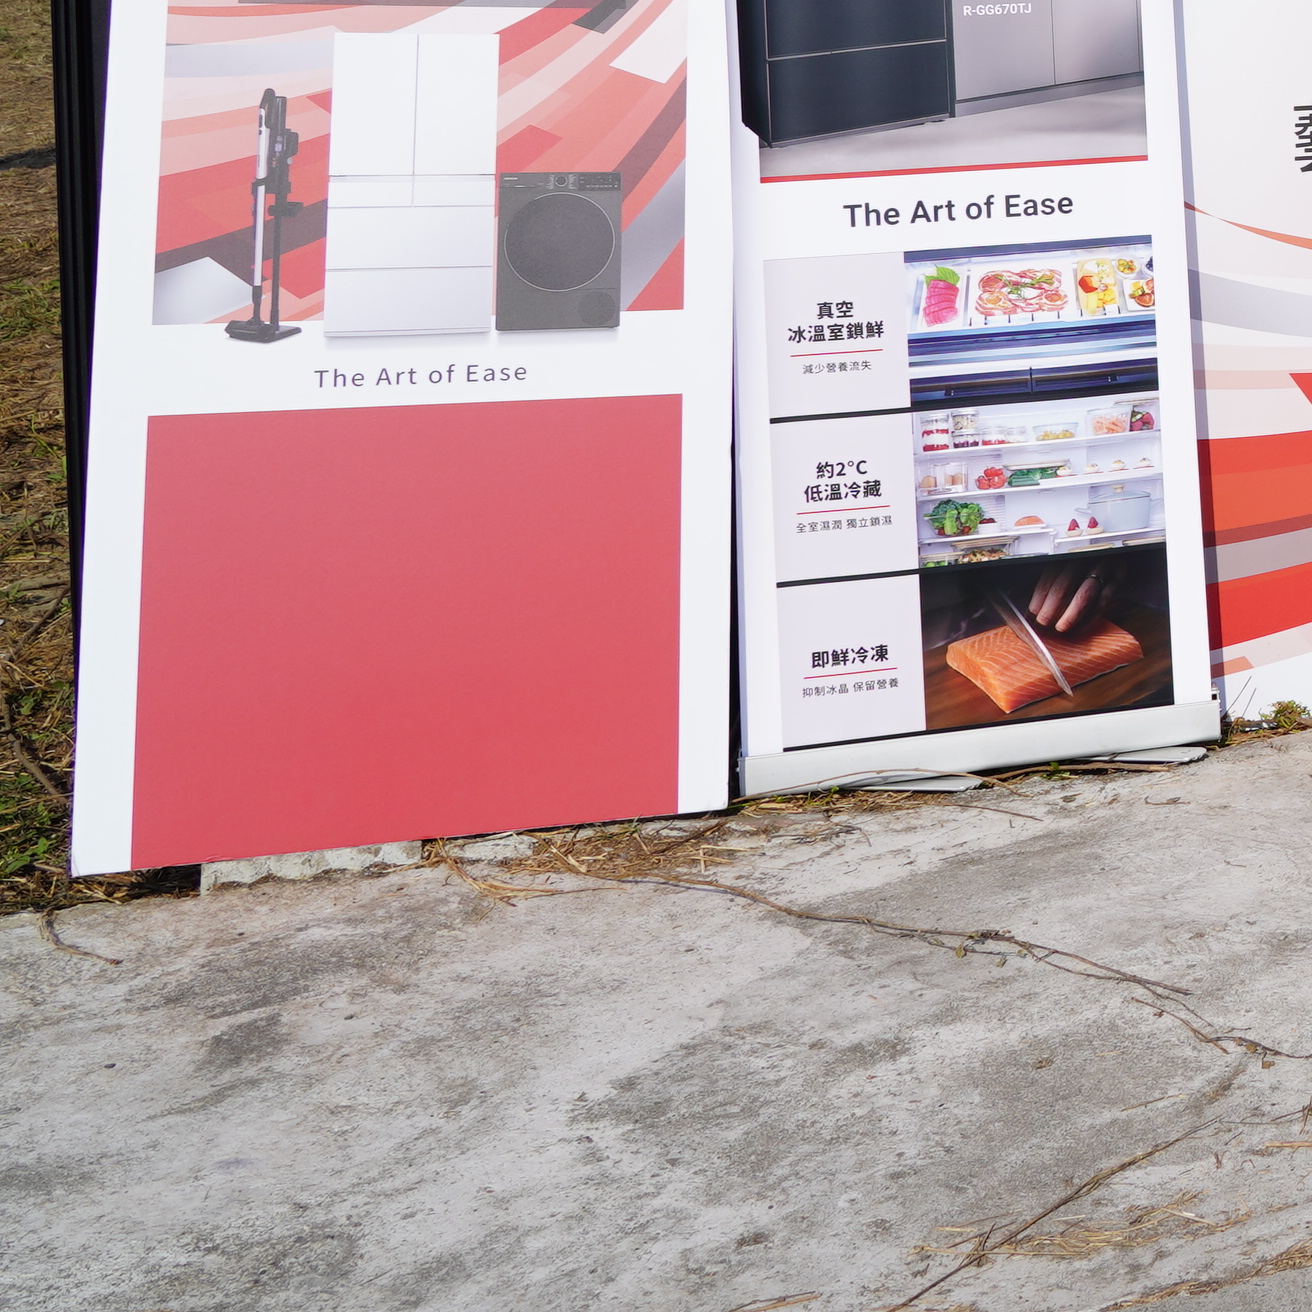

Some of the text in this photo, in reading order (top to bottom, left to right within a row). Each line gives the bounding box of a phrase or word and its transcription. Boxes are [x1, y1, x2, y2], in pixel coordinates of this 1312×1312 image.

[963, 1, 1032, 16] R-GG670TJ
[843, 193, 1073, 228] The Art of Ease
[816, 300, 855, 320] 真空
[788, 321, 885, 345] 冰溫室鎖鮮
[315, 363, 528, 389] The Art of Ease
[803, 360, 872, 375] 減少營養流失
[816, 459, 868, 480] 約2°C
[804, 480, 882, 504] 低溫冷藏
[796, 515, 893, 535] 全室濕潤 獨立鎖濕
[811, 644, 889, 669] 即鮮冷凍
[802, 679, 900, 699] 抑制冰晶 保留營養
